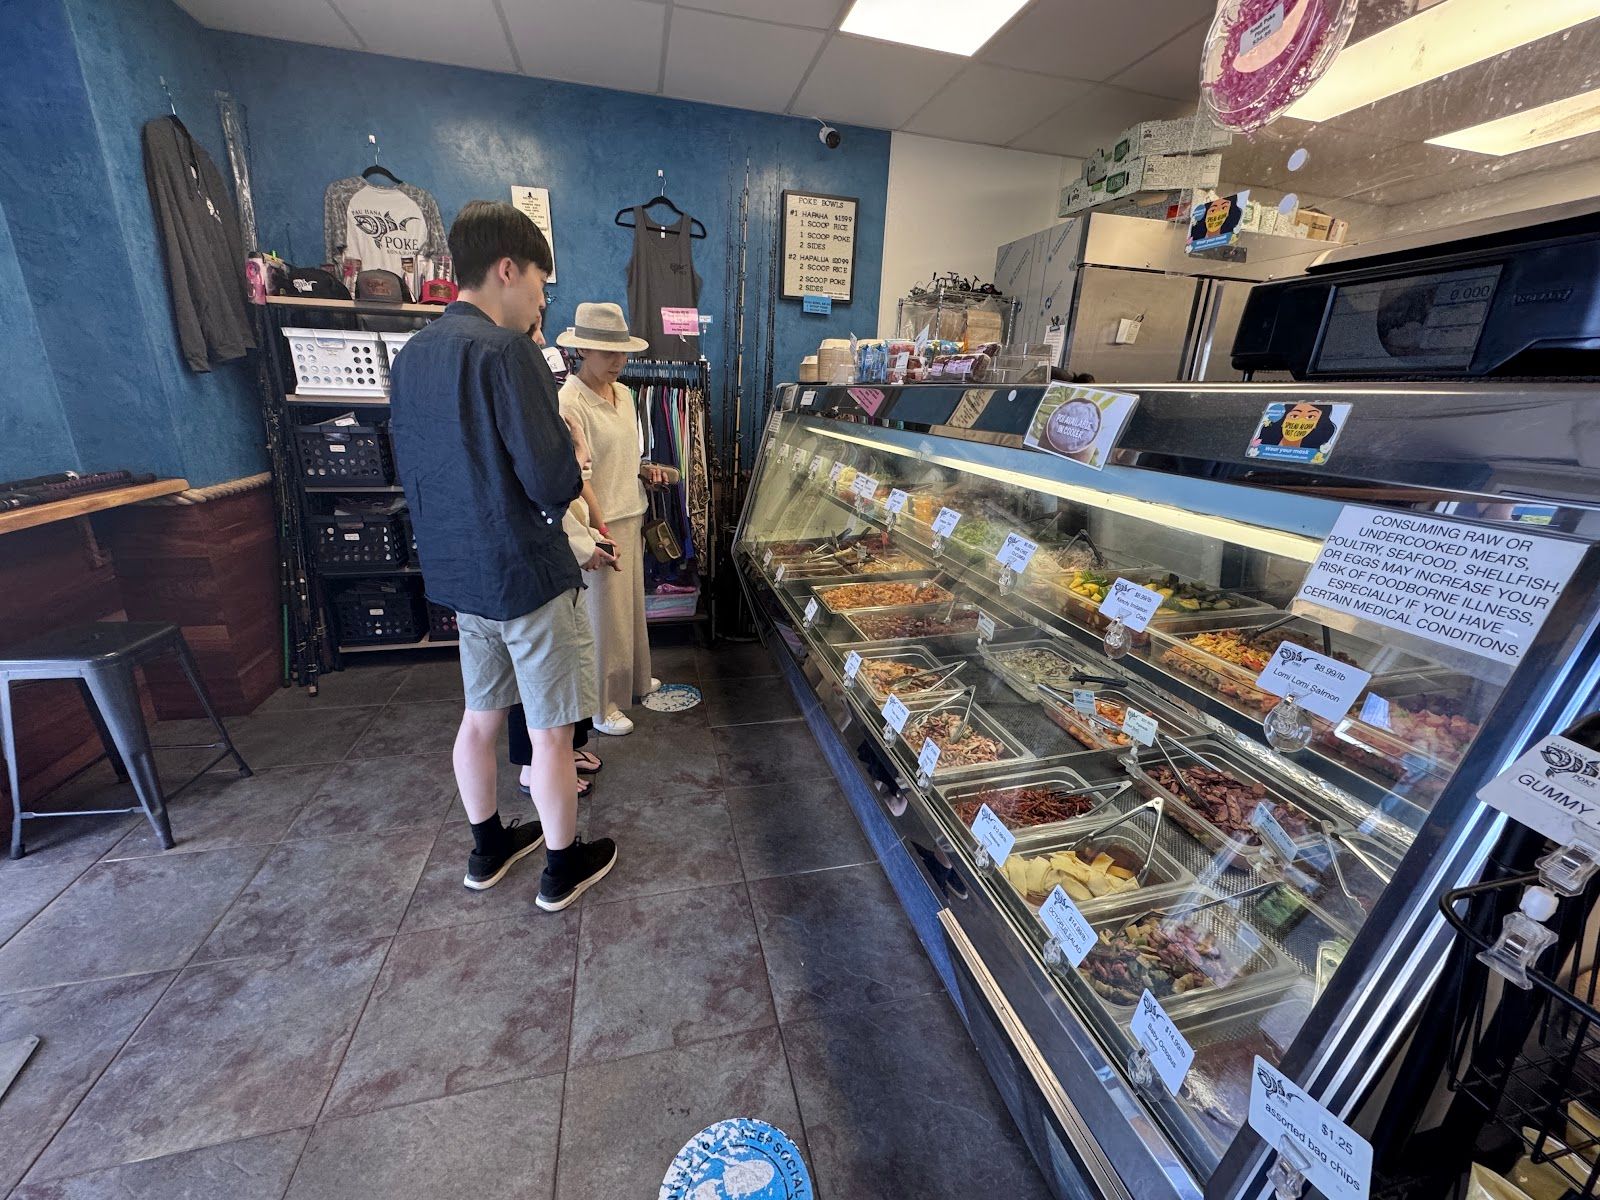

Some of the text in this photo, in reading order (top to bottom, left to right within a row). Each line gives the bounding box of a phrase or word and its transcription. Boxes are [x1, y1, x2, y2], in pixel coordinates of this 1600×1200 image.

[798, 197, 844, 209] POKE BOWLS
[807, 220, 830, 229] SCOOP
[833, 223, 848, 231] RICE
[384, 236, 419, 251] POKE
[799, 241, 826, 251] 2 SIDES
[807, 232, 830, 240] SCOOP
[833, 235, 851, 243] POKE
[807, 263, 830, 272] SCOOP
[832, 266, 848, 274] RICE
[805, 276, 828, 284] SCOOP
[829, 278, 846, 286] POKE
[805, 284, 824, 292] SIDES
[1064, 416, 1094, 431] AVAILABLE
[1064, 425, 1085, 440] COOLER
[1372, 514, 1534, 552] CONSUMING RAW OR
[1358, 527, 1530, 571] UNDERCOOKED MEATS,
[1326, 535, 1561, 596] POULTRY, SEAFOOD, SHELLFISH,
[1323, 548, 1550, 610] OR EGGS MAY INCREASE YOUR
[1317, 561, 1535, 627] RISK OF FOODBORNE ILLNESS,
[1327, 577, 1504, 634] ESPECIALLY IF YOU HAVE
[1135, 613, 1147, 622] Crab
[1302, 585, 1521, 659] CERTAIN MEDICAL CONDITIONS.
[1313, 663, 1347, 682] $8.99/lb
[1273, 667, 1341, 703] Lomi Lomi Salmon
[1551, 742, 1588, 761] PAU HANA
[1571, 774, 1598, 788] POKE
[1518, 774, 1595, 815] GUMMY
[1147, 1022, 1177, 1069] Baby Octopus
[1265, 1103, 1361, 1192] assorted bag chips
[1321, 1123, 1354, 1156] $1.25
[773, 1142, 806, 1199] SOCIAL
